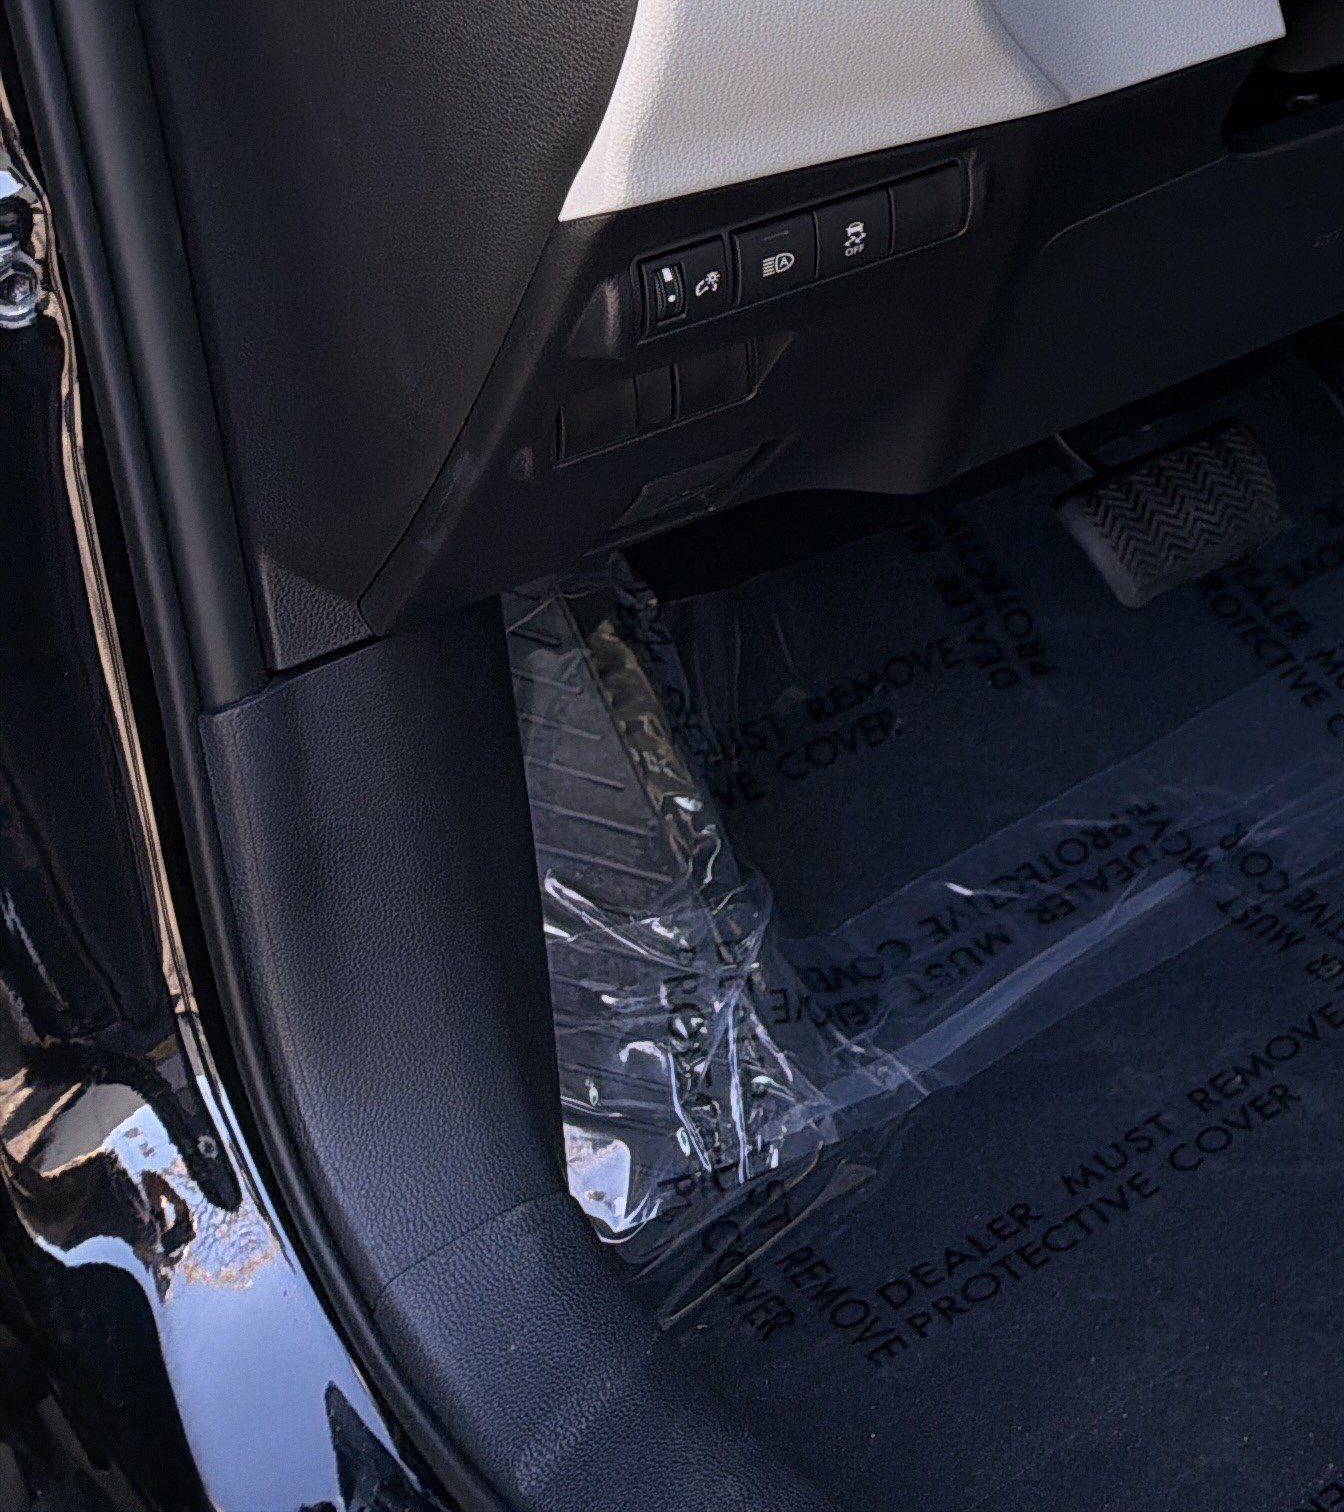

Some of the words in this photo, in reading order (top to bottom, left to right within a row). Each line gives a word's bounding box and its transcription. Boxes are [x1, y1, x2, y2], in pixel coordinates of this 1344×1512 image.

[844, 242, 866, 258] OFF
[877, 1194, 1042, 1315] DEALER
[1058, 1110, 1175, 1198] MUST
[905, 1168, 1159, 1345] PROTECTIVE
[1164, 1076, 1302, 1178] COVER
[702, 1221, 798, 1341] COVER
[776, 1244, 908, 1368] REMOVE
